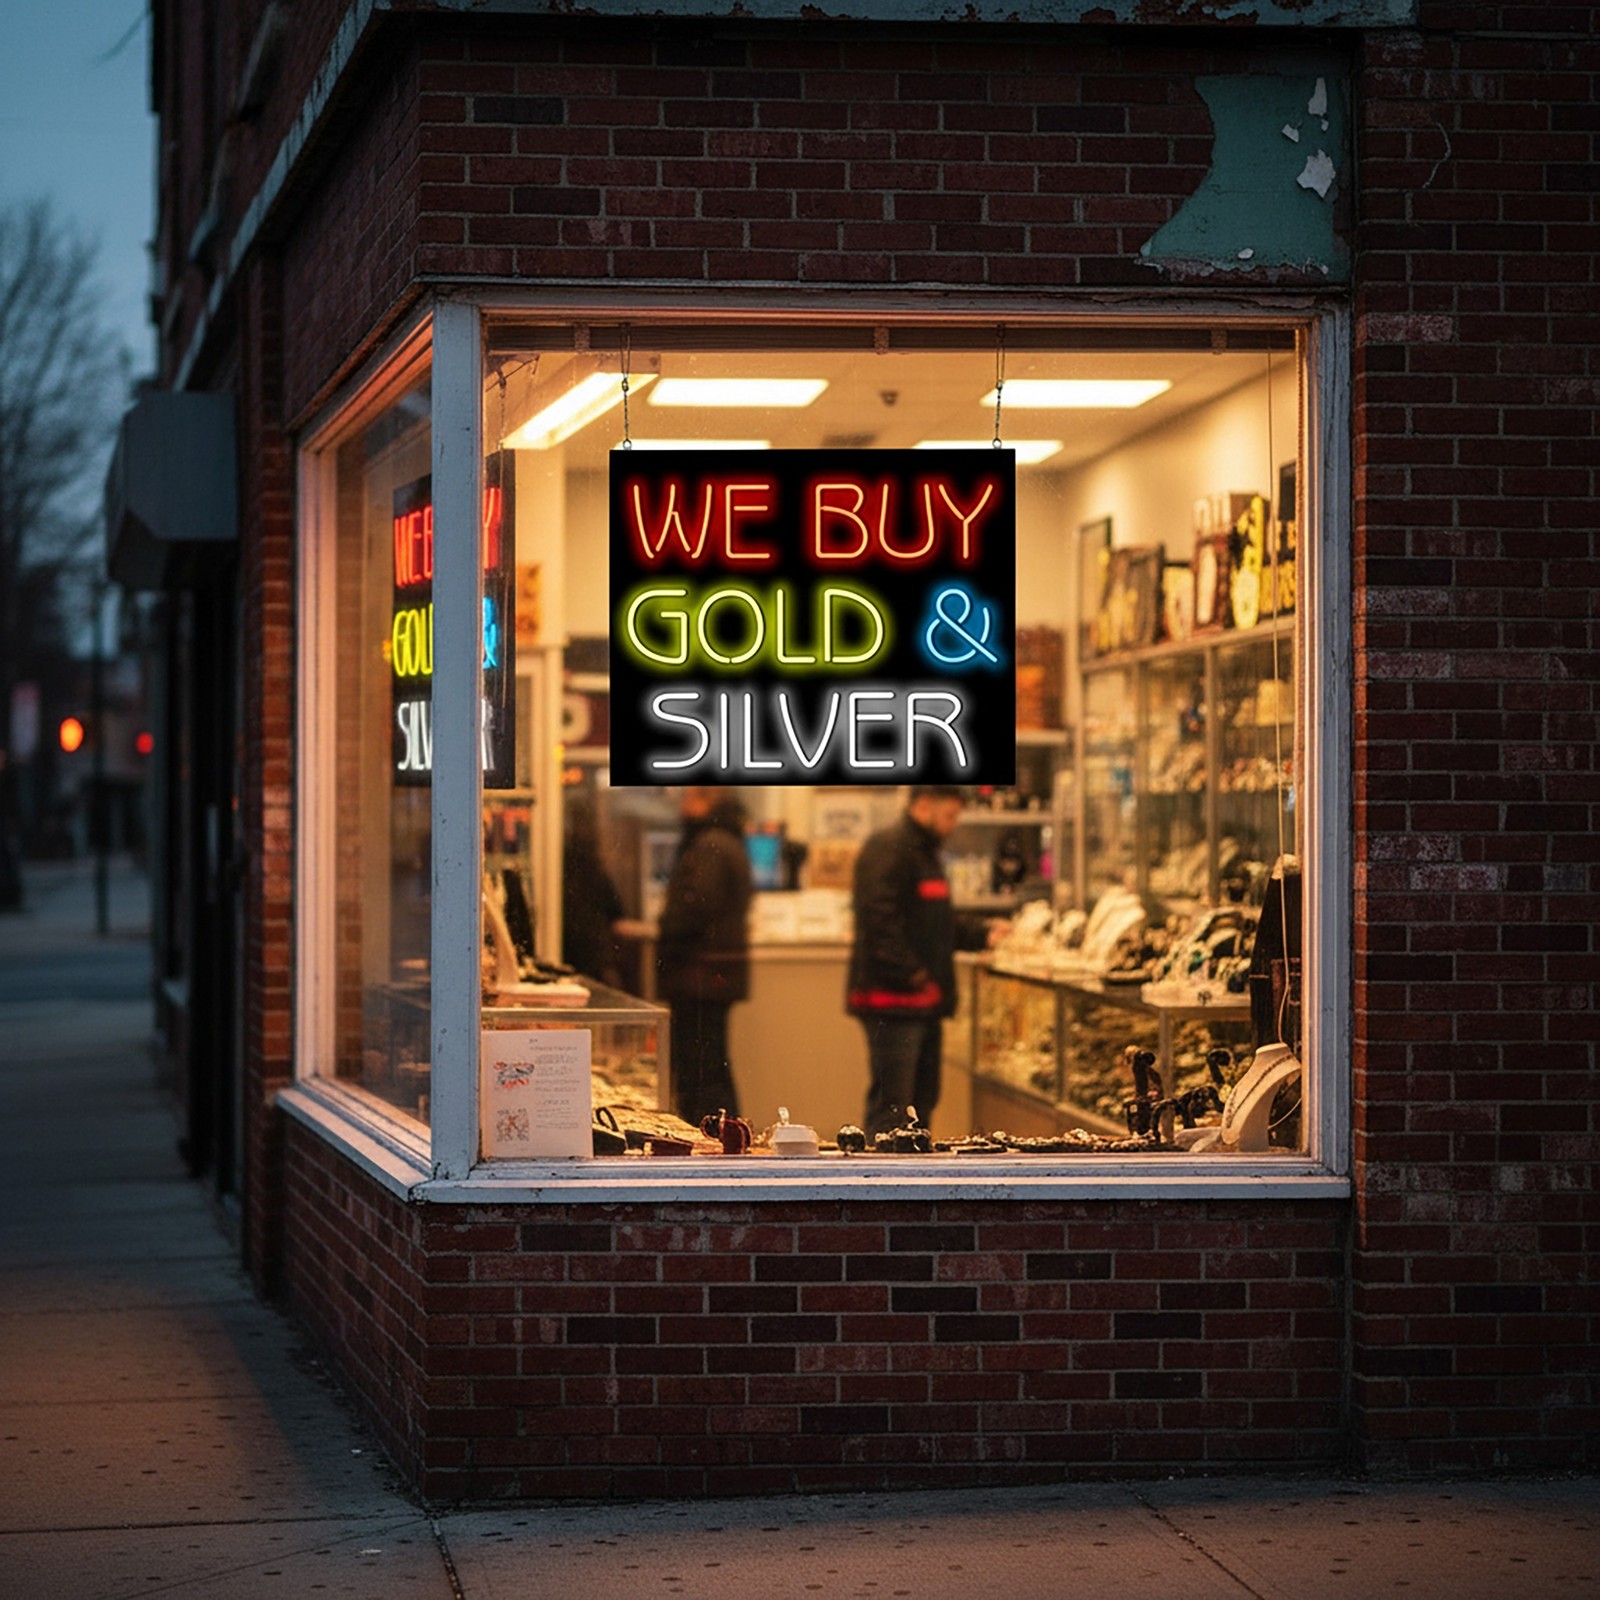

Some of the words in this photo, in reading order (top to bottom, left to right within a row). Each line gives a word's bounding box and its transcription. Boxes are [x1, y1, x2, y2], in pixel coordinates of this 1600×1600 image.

[634, 485, 769, 558] WE
[816, 484, 992, 558] BUY
[393, 602, 433, 677] GOL
[628, 589, 882, 663] GOLD
[927, 589, 997, 662] &
[653, 693, 965, 768] SILVER
